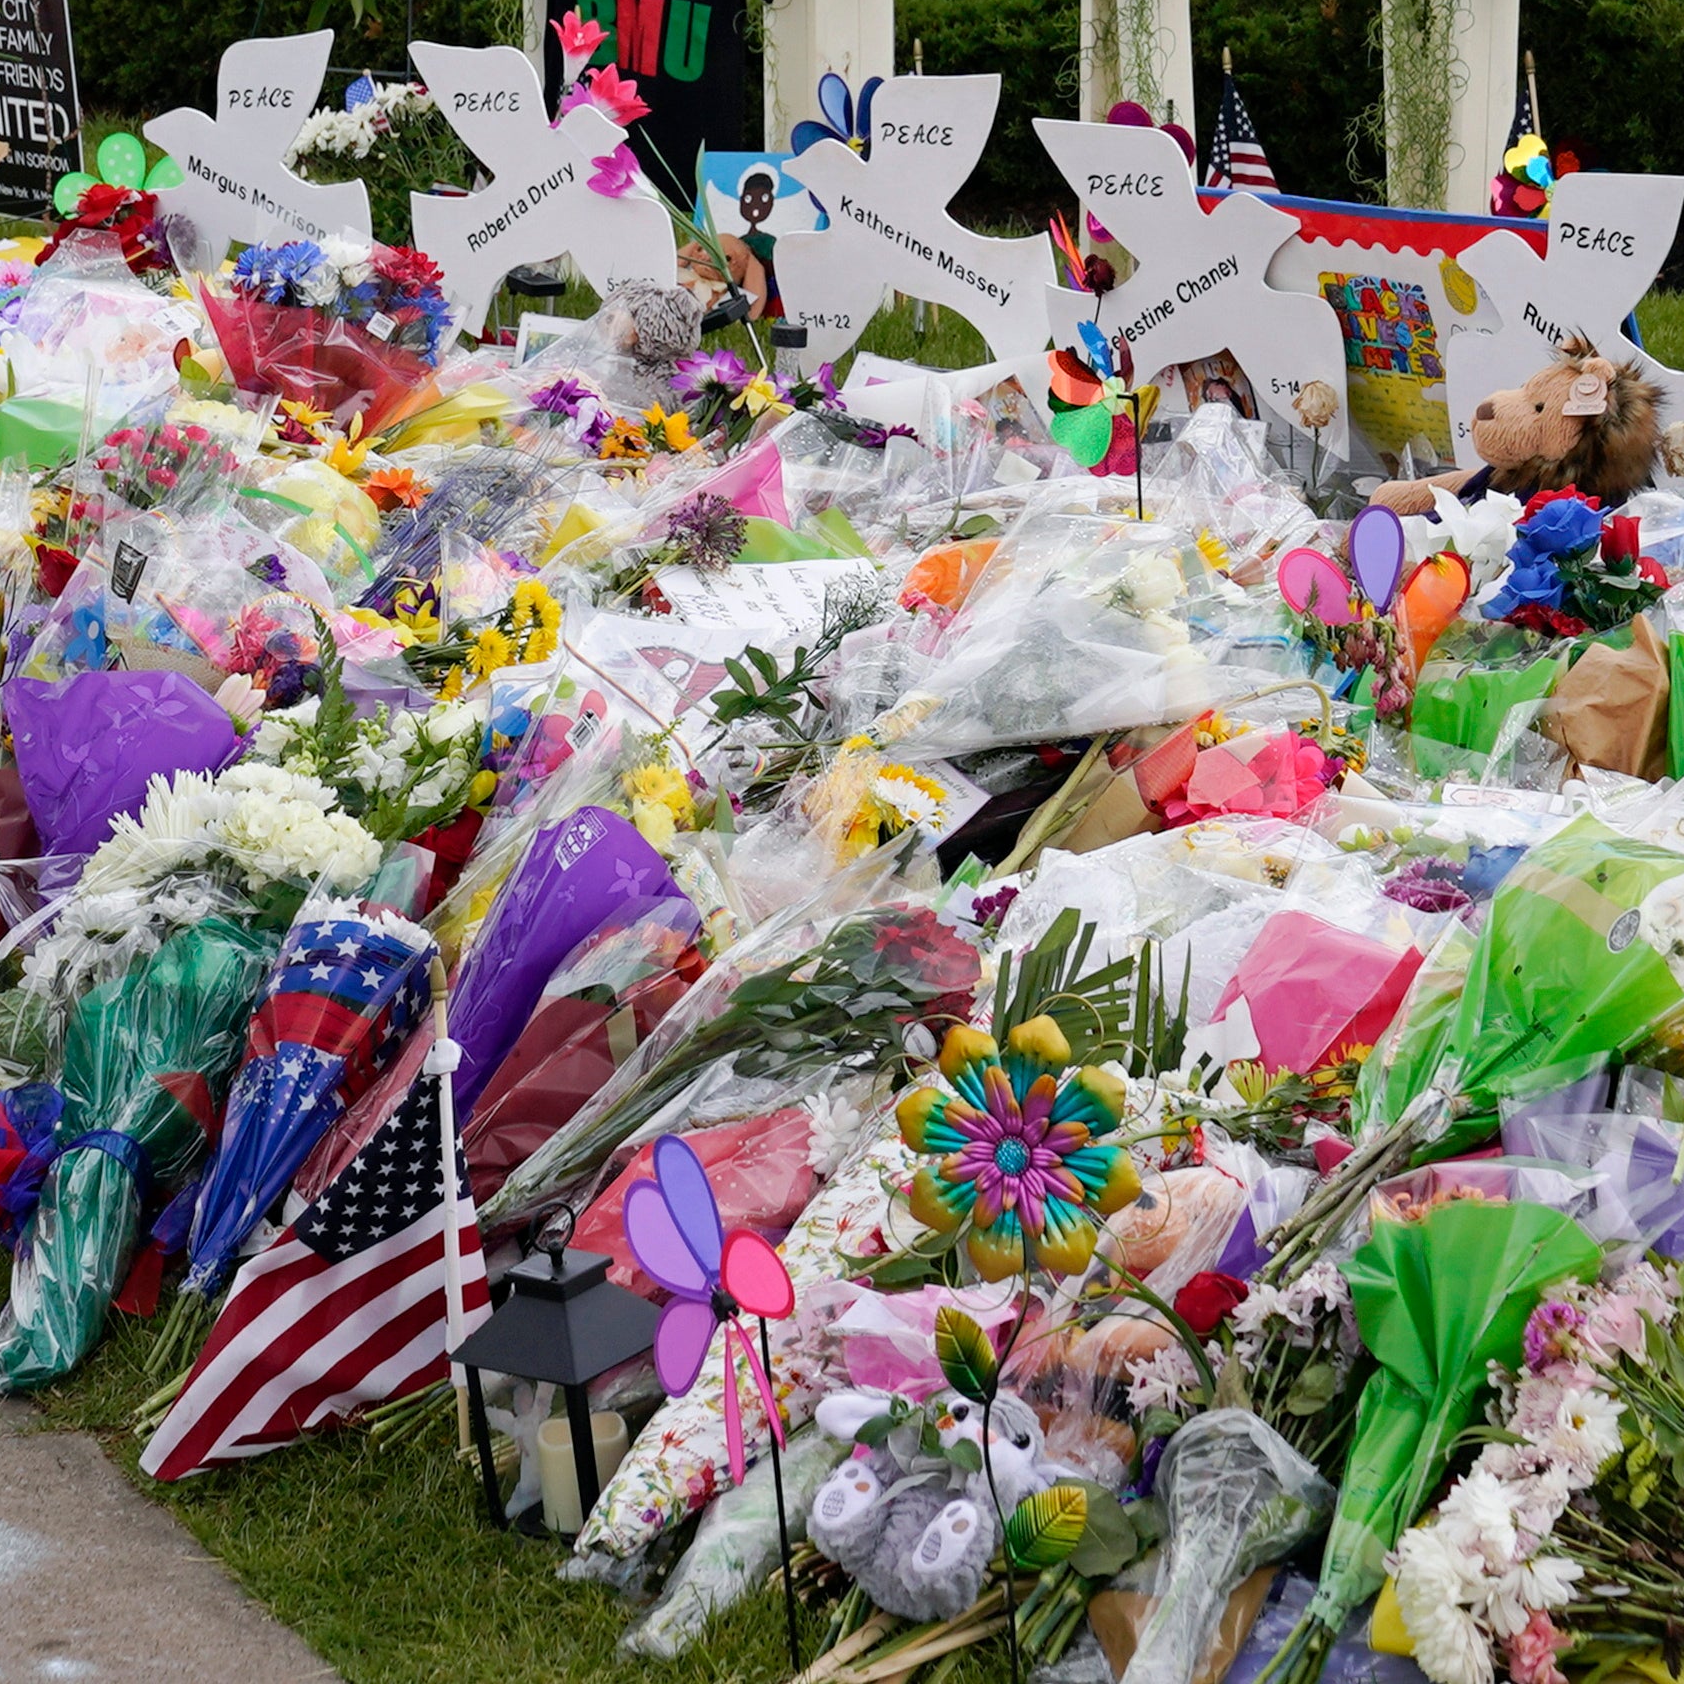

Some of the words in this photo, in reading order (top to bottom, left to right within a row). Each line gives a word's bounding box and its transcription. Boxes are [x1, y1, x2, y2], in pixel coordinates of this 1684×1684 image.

[228, 86, 294, 108] PEACE
[453, 91, 520, 113] PEACE
[881, 122, 954, 145] PEACE
[15, 150, 26, 166] IN
[188, 155, 246, 201] Margus
[252, 188, 327, 240] Morrison
[1088, 173, 1164, 196] PEACE
[467, 198, 528, 252] Roberta
[528, 162, 575, 204] Drury
[840, 195, 933, 260] Katherine
[937, 250, 1011, 307] Massey
[1559, 222, 1635, 257] PEACE
[1109, 299, 1175, 354] elestine
[1176, 254, 1239, 304] Chaney
[1324, 283, 1417, 320] BLACK
[799, 312, 851, 329] 5-14-22
